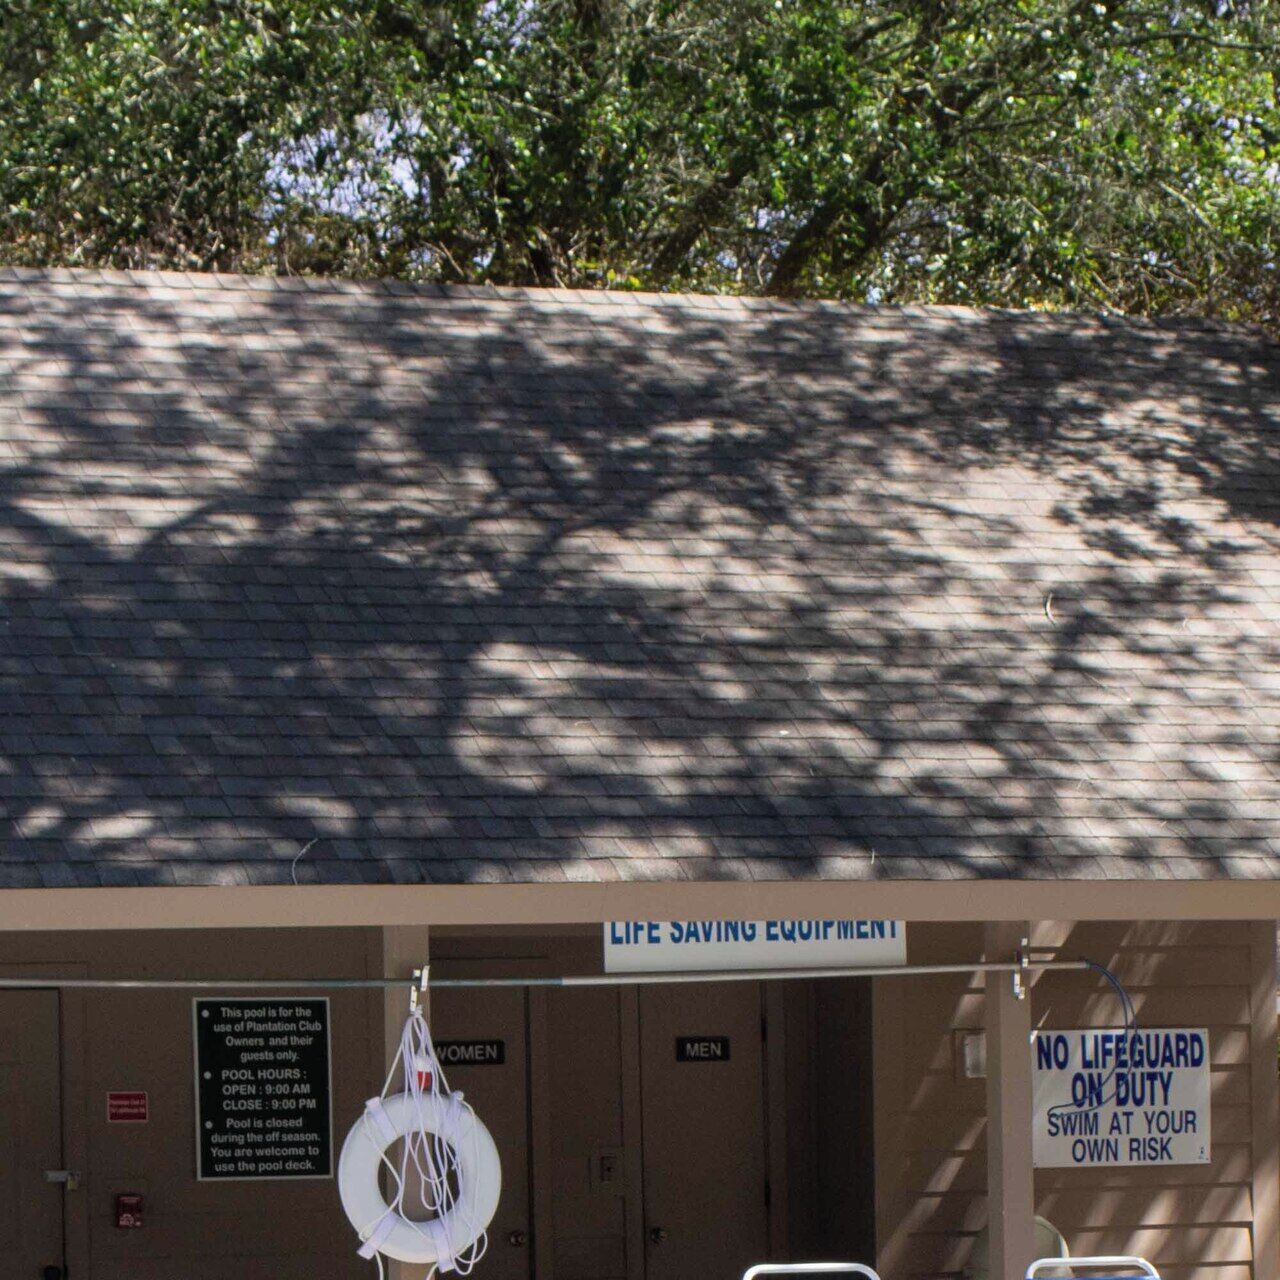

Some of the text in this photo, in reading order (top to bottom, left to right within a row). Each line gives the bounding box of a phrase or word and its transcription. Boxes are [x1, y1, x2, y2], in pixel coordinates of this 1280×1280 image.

[610, 921, 662, 945] LIFE
[669, 920, 757, 944] SAVING
[220, 1006, 312, 1020] This pool is for the
[213, 1020, 322, 1032] use of Plantation Club
[225, 1035, 314, 1047] Owners and their
[240, 1050, 274, 1063] guests
[685, 1042, 721, 1058] MEN
[1037, 1033, 1204, 1070] NO LIFEGUARD
[221, 1069, 255, 1080] POOL
[257, 1068, 301, 1079] HOURS
[222, 1084, 256, 1095] OPEN
[264, 1084, 290, 1095] 9:00
[292, 1083, 311, 1094] AM
[1071, 1071, 1173, 1107] ON DUTY
[222, 1099, 262, 1110] CLOSE
[271, 1099, 296, 1110] 9:00
[298, 1098, 317, 1109] PM
[226, 1116, 303, 1129] Pool is closed
[1047, 1110, 1197, 1137] SWIM AT YOUR
[210, 1133, 245, 1145] during
[247, 1132, 263, 1142] the
[265, 1131, 280, 1142] off
[210, 1145, 320, 1158] You are welcome to
[1071, 1138, 1118, 1163] OWN
[1129, 1137, 1173, 1161] RISK
[214, 1163, 235, 1172] use
[237, 1161, 256, 1172] the
[258, 1160, 283, 1173] pool
